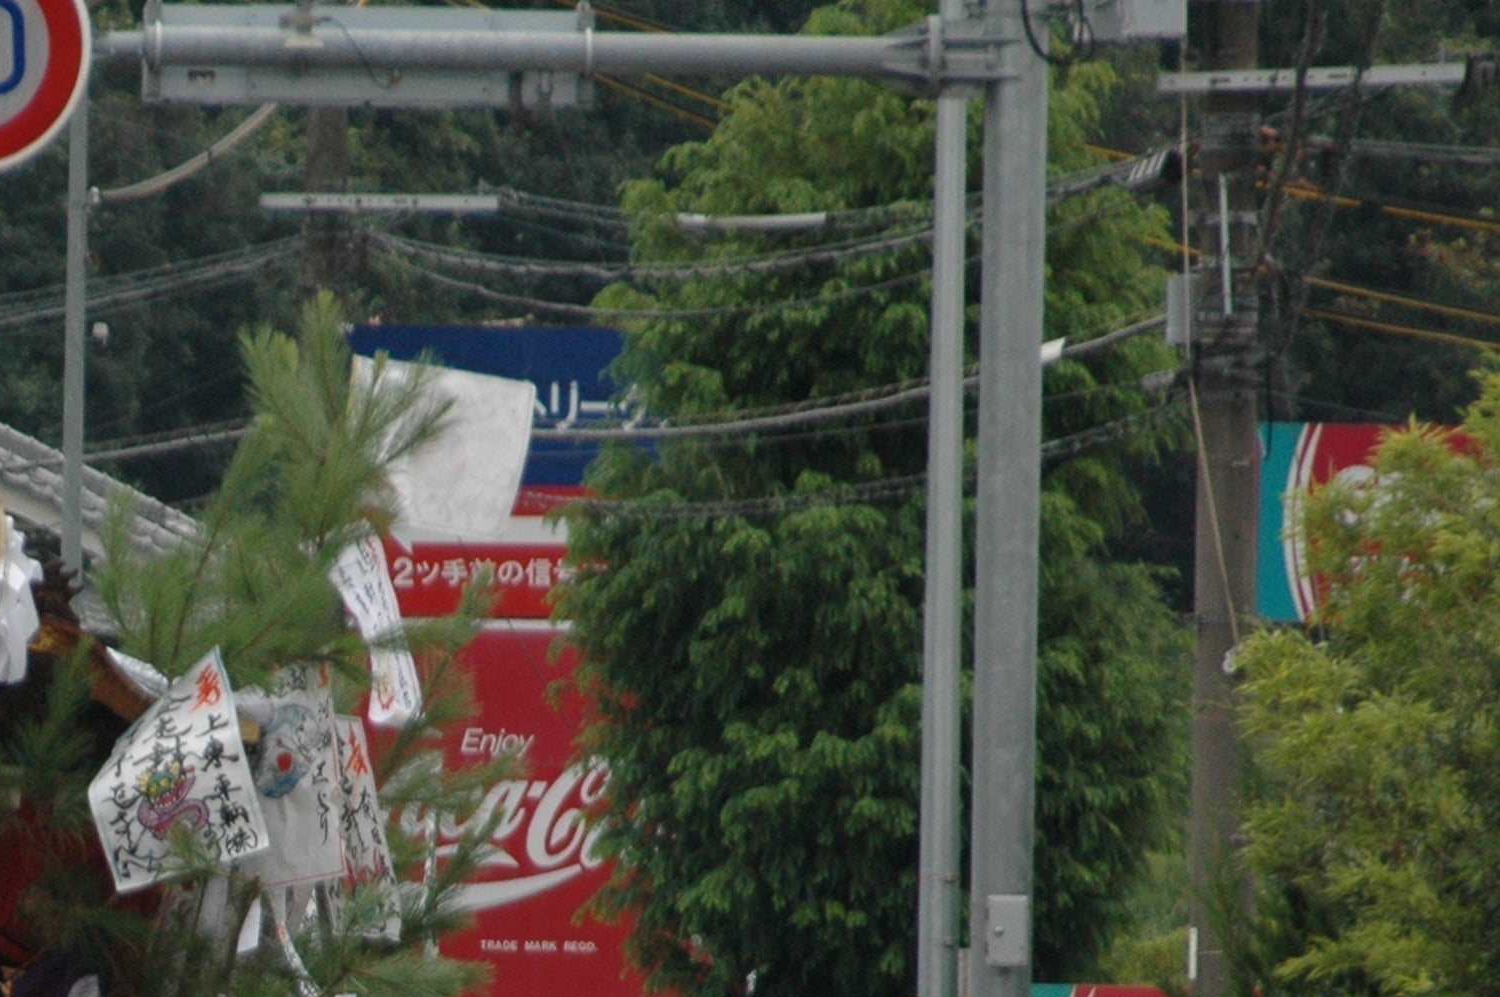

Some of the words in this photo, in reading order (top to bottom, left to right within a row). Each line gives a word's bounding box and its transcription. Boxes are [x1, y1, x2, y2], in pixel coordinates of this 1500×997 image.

[460, 728, 534, 758] Enjoy
[480, 940, 518, 950] TRADE
[524, 940, 557, 950] MARK
